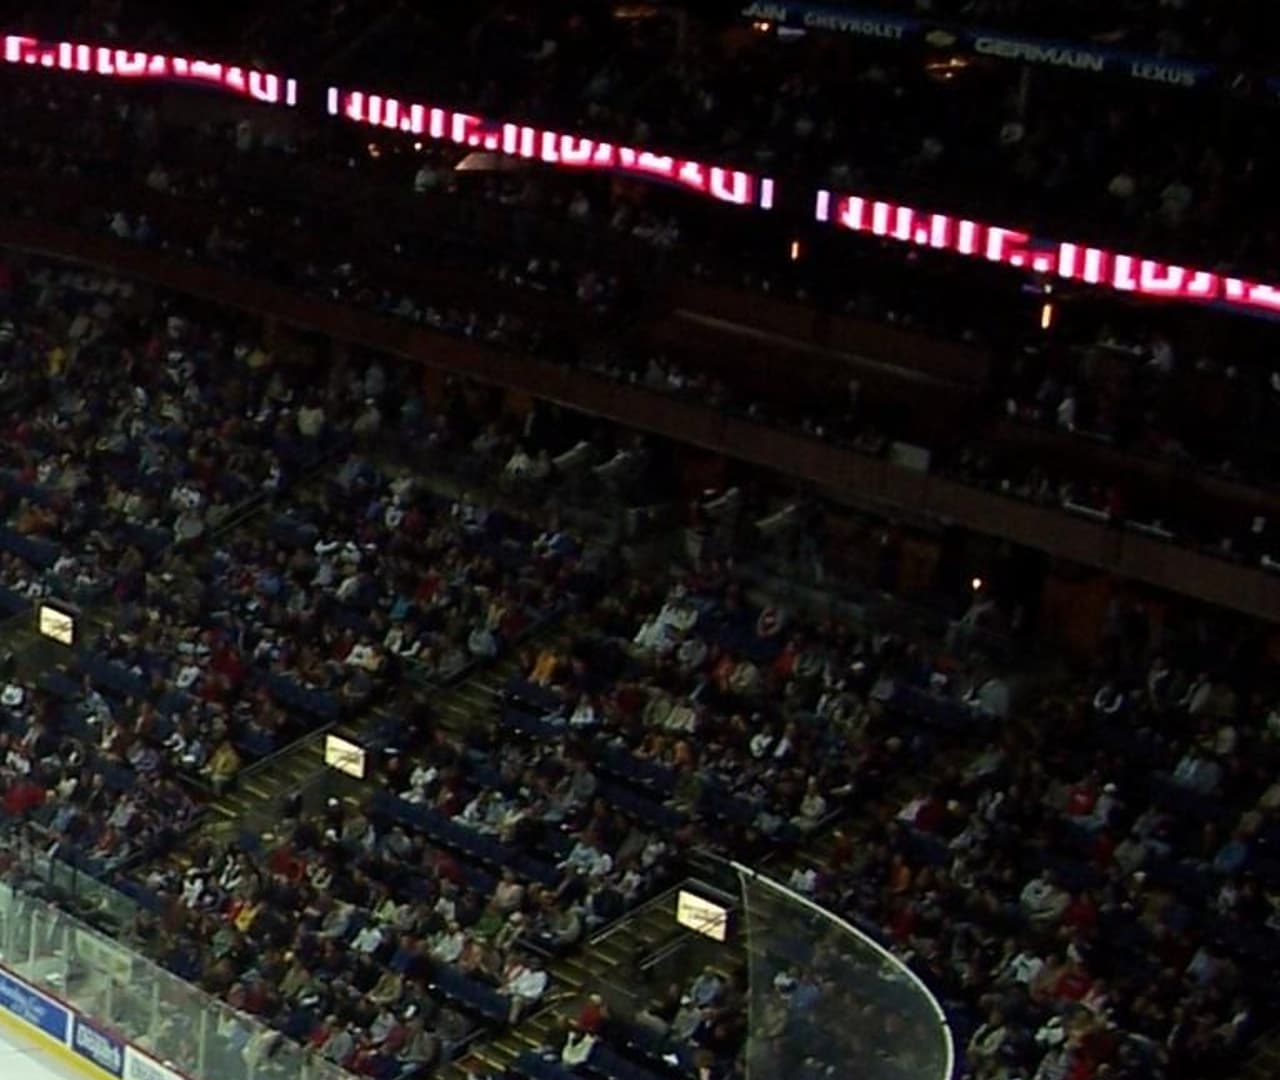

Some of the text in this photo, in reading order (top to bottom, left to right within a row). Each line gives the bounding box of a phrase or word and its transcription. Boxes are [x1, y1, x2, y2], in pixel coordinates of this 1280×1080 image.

[803, 11, 904, 40] CHEVROLET
[974, 36, 1197, 88] GERMAIN LEXUS
